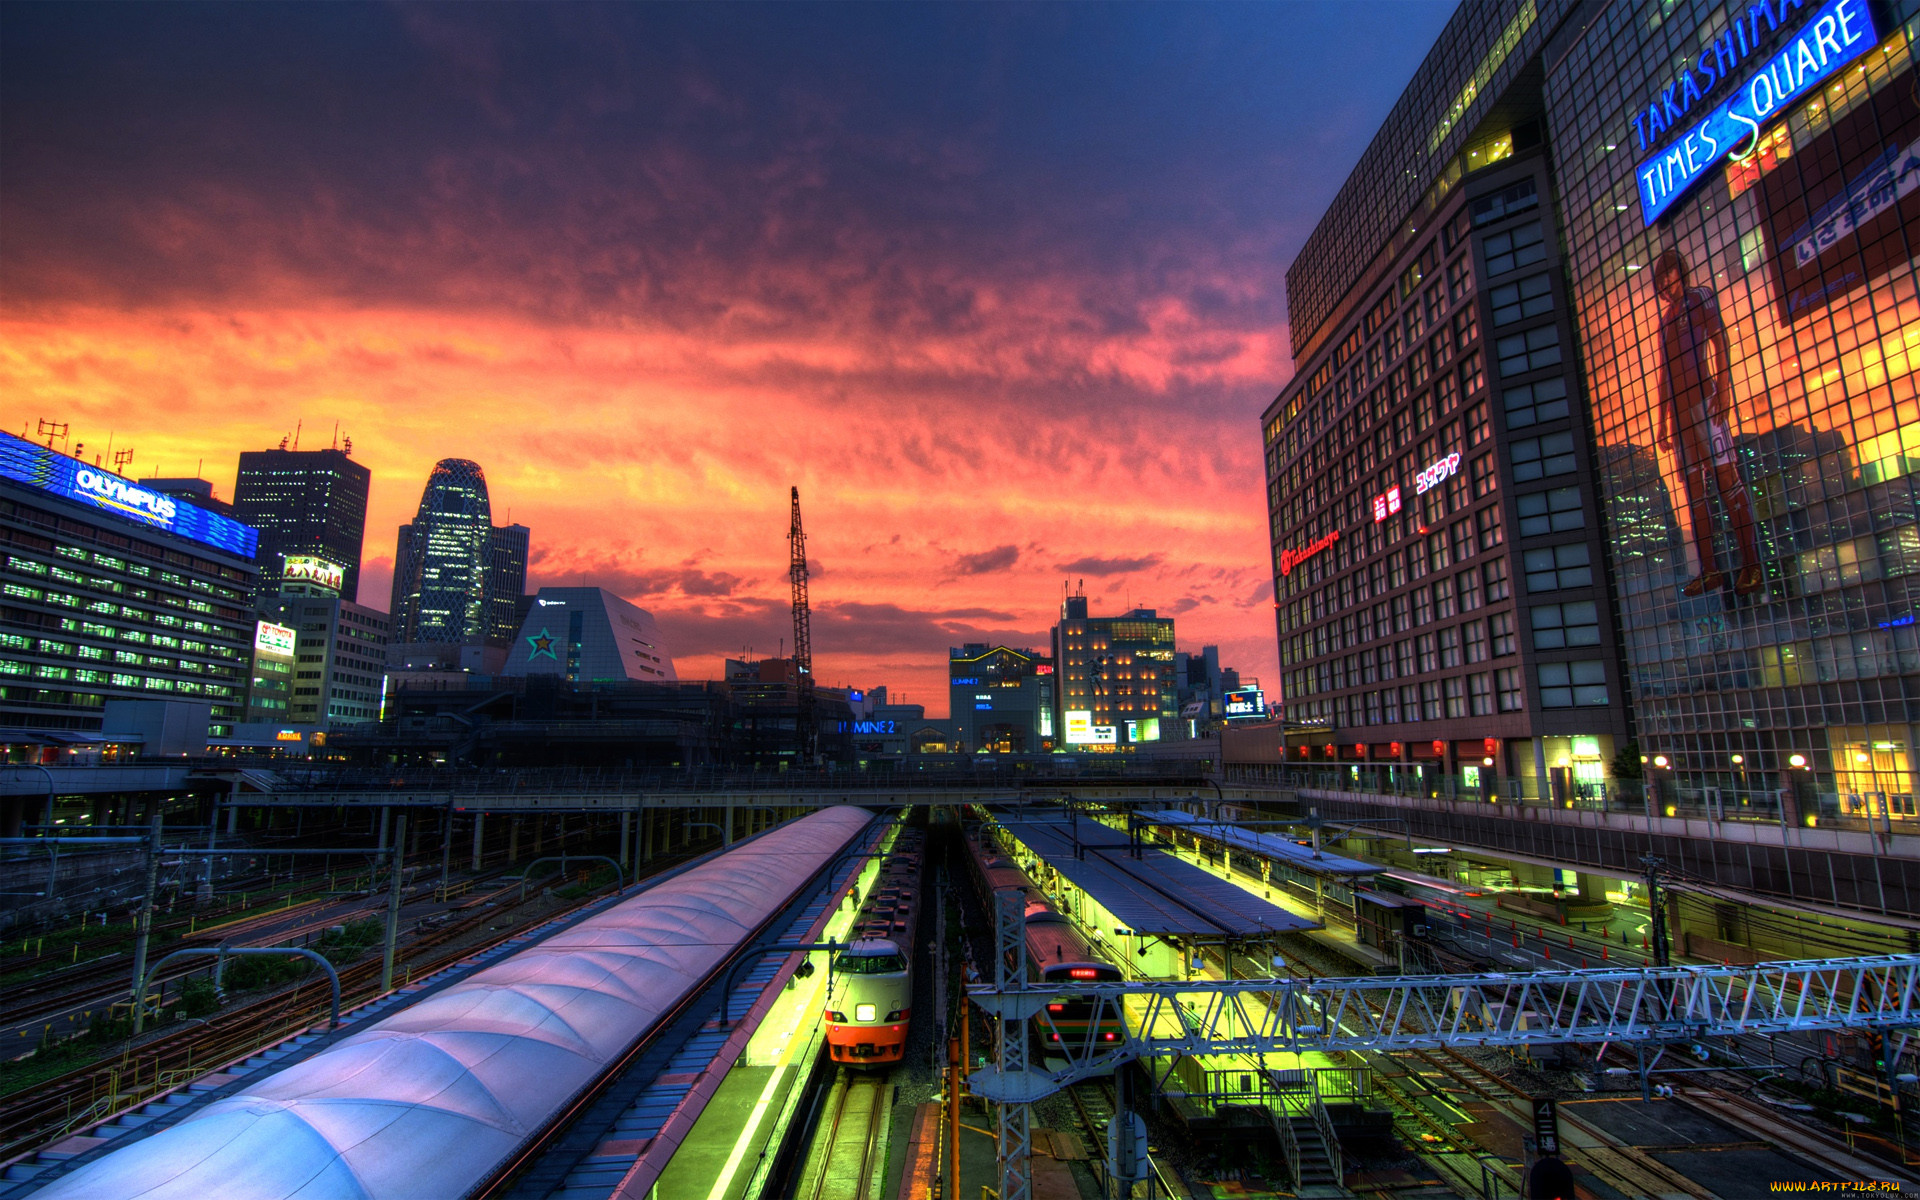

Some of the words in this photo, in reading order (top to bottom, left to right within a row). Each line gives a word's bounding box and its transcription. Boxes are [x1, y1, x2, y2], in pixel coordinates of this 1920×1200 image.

[1643, 119, 1718, 207] TIMES
[1728, 0, 1862, 161] SQUARE
[76, 469, 176, 518] OLYMPUS
[1416, 452, 1460, 495] ユザワヤ
[1290, 530, 1339, 567] Takashimaya
[272, 626, 292, 638] TOYOTA
[888, 720, 895, 735] 2
